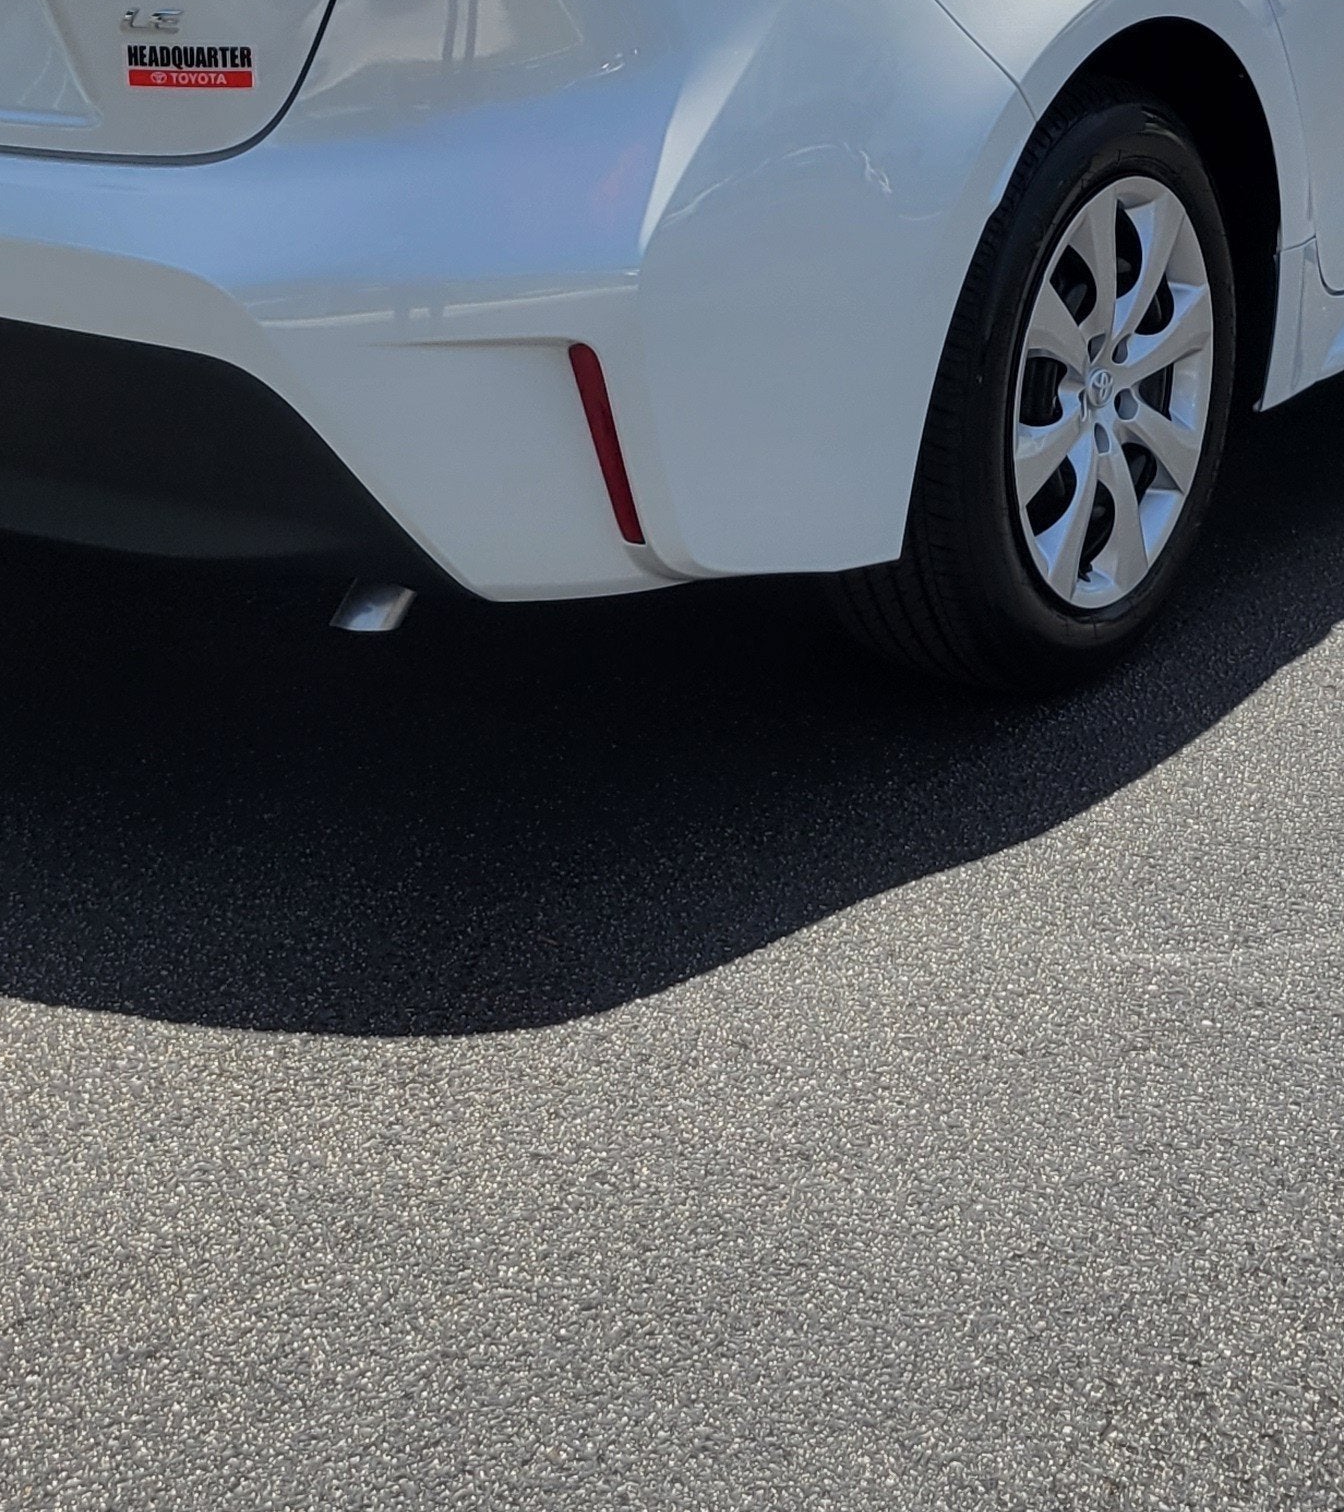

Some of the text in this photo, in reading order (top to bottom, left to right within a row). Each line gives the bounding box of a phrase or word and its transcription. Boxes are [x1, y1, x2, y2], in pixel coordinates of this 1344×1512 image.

[120, 7, 184, 35] LE
[127, 44, 253, 70] HEADQUARTER
[171, 72, 228, 85] TOYOTA
